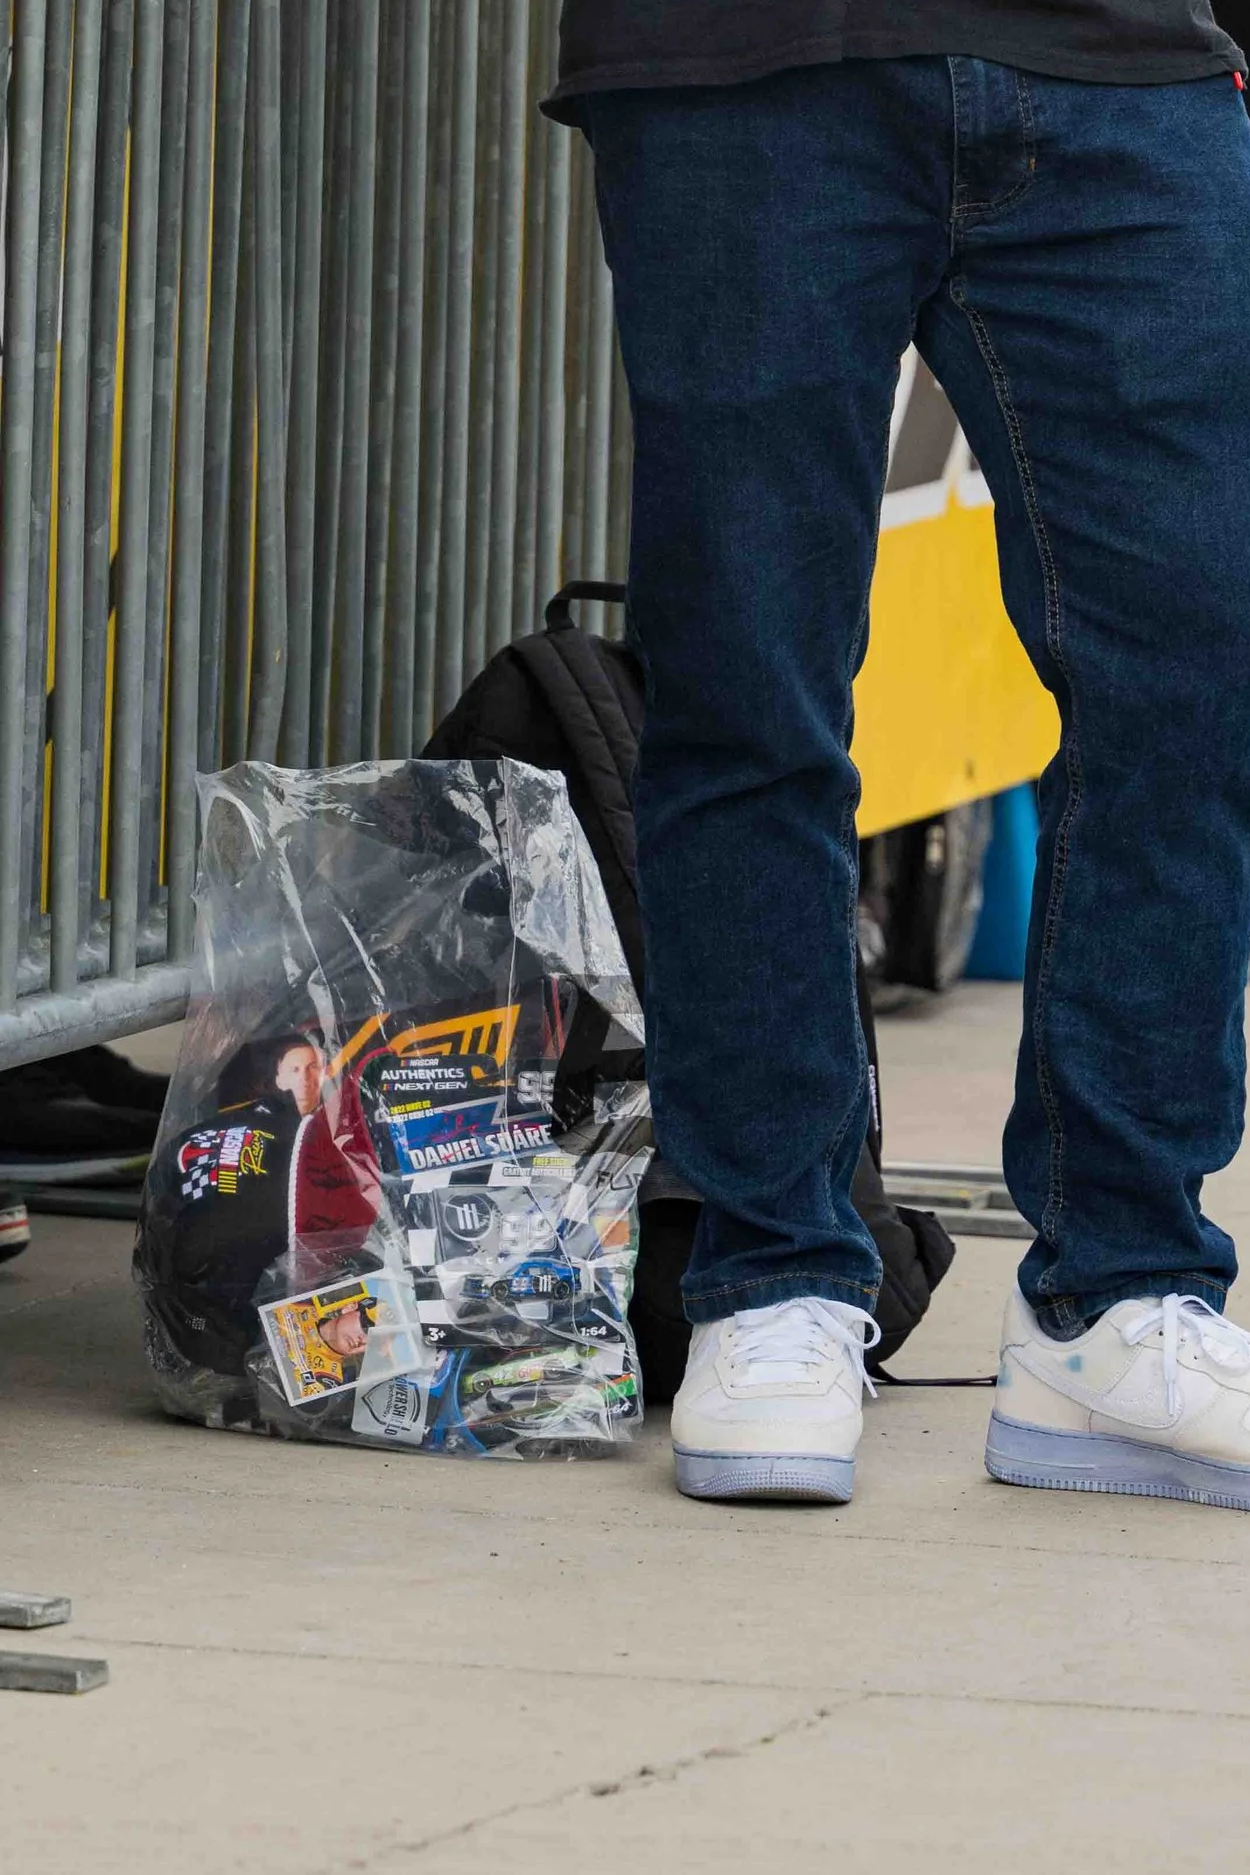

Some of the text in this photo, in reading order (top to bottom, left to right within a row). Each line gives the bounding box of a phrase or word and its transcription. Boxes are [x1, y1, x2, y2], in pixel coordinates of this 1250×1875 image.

[410, 1057, 439, 1067] NASCAR
[381, 1068, 465, 1080] AUTHENTICS
[394, 1081, 468, 1091] NEXT GEN
[240, 1129, 275, 1175] Racing
[408, 1123, 552, 1170] DANIEL SUÁRE
[428, 1326, 607, 1341] 3+ 1:64
